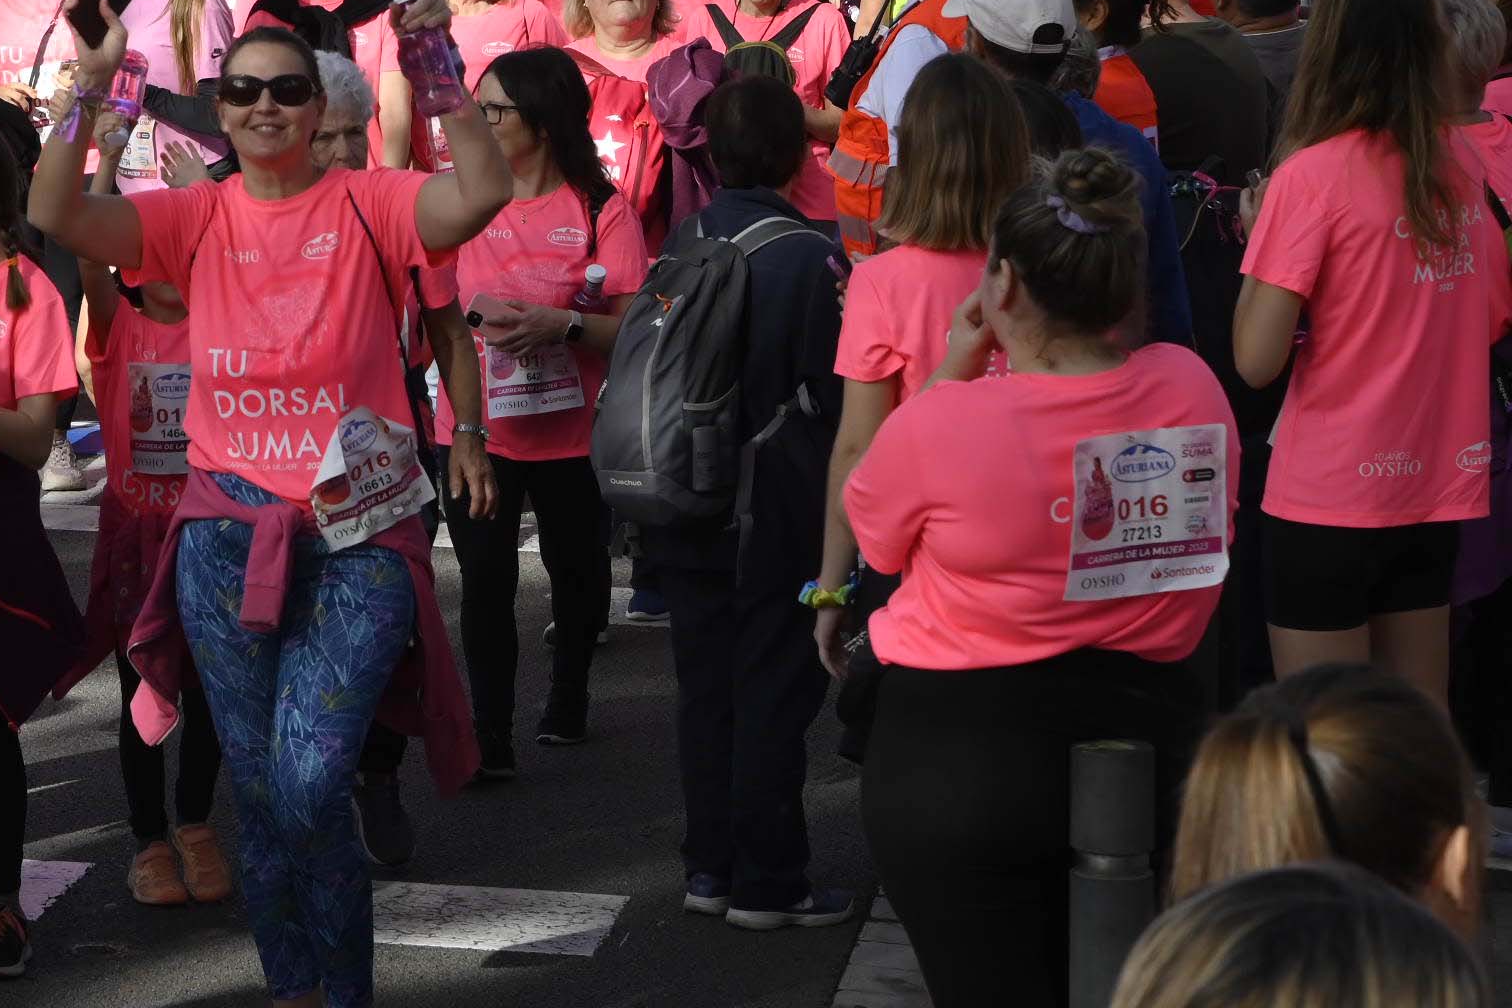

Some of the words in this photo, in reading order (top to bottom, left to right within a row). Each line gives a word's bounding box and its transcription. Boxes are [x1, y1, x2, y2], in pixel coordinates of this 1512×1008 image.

[0, 47, 23, 63] TU
[550, 232, 586, 243] ASTURIANA
[1413, 253, 1476, 285] MUJER
[207, 347, 248, 378] TU
[213, 383, 350, 419] DORSAL
[156, 408, 185, 424] 01
[175, 442, 185, 450] LA
[226, 427, 322, 461] SUMA
[1181, 447, 1215, 458] SUMA
[350, 451, 392, 482] 016
[1115, 460, 1170, 476] ASTURIANA
[1358, 459, 1422, 478] OYSHO
[357, 473, 393, 495] 16613
[1117, 494, 1169, 521] 016
[1122, 525, 1162, 543] 27213
[1087, 553, 1125, 565] CARRERA
[1125, 550, 1138, 559] DE
[1138, 548, 1151, 557] LA
[1152, 544, 1186, 555] MUJER
[1080, 573, 1126, 590] OYSHO
[1163, 564, 1216, 578] Santander
